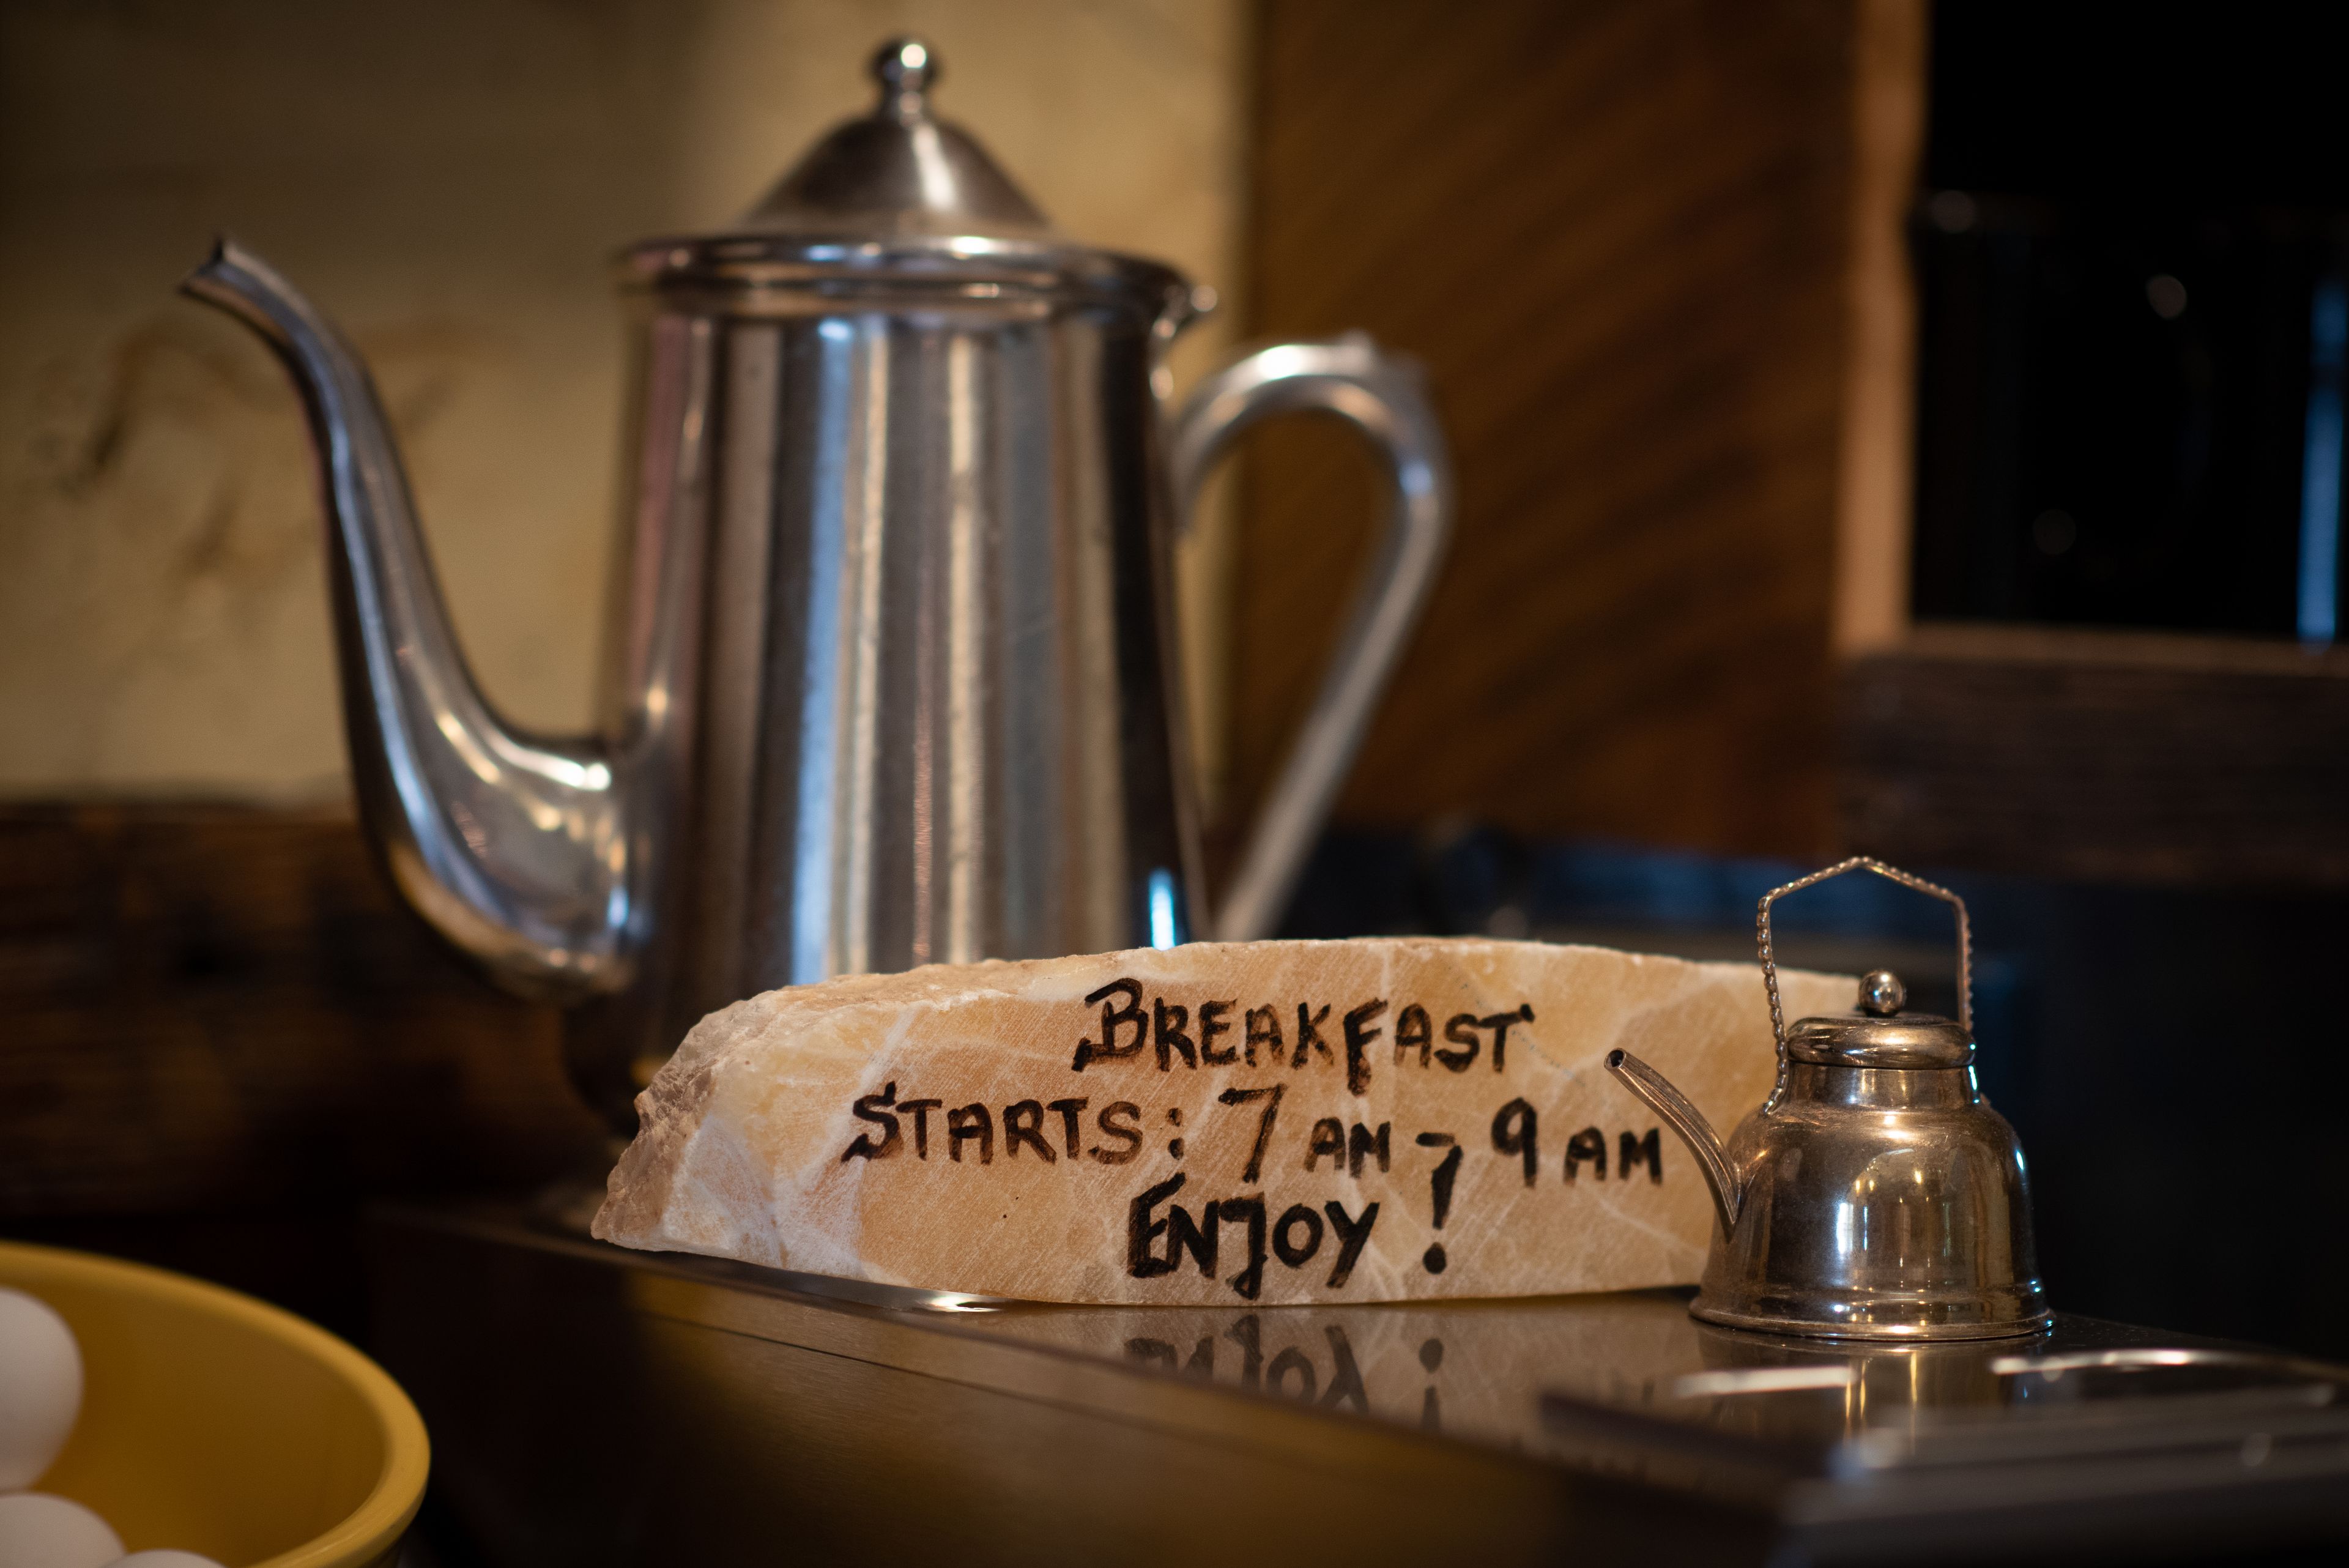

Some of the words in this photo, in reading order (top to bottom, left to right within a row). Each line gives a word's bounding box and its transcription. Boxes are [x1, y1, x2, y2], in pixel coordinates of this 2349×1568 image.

[1071, 977, 1535, 1097] BREAKFAST
[840, 1080, 1184, 1166] STARTS:
[1217, 1082, 1289, 1186] 7
[1302, 1116, 1393, 1180] AM
[1490, 1096, 1540, 1189] 9
[1562, 1125, 1665, 1186] AM
